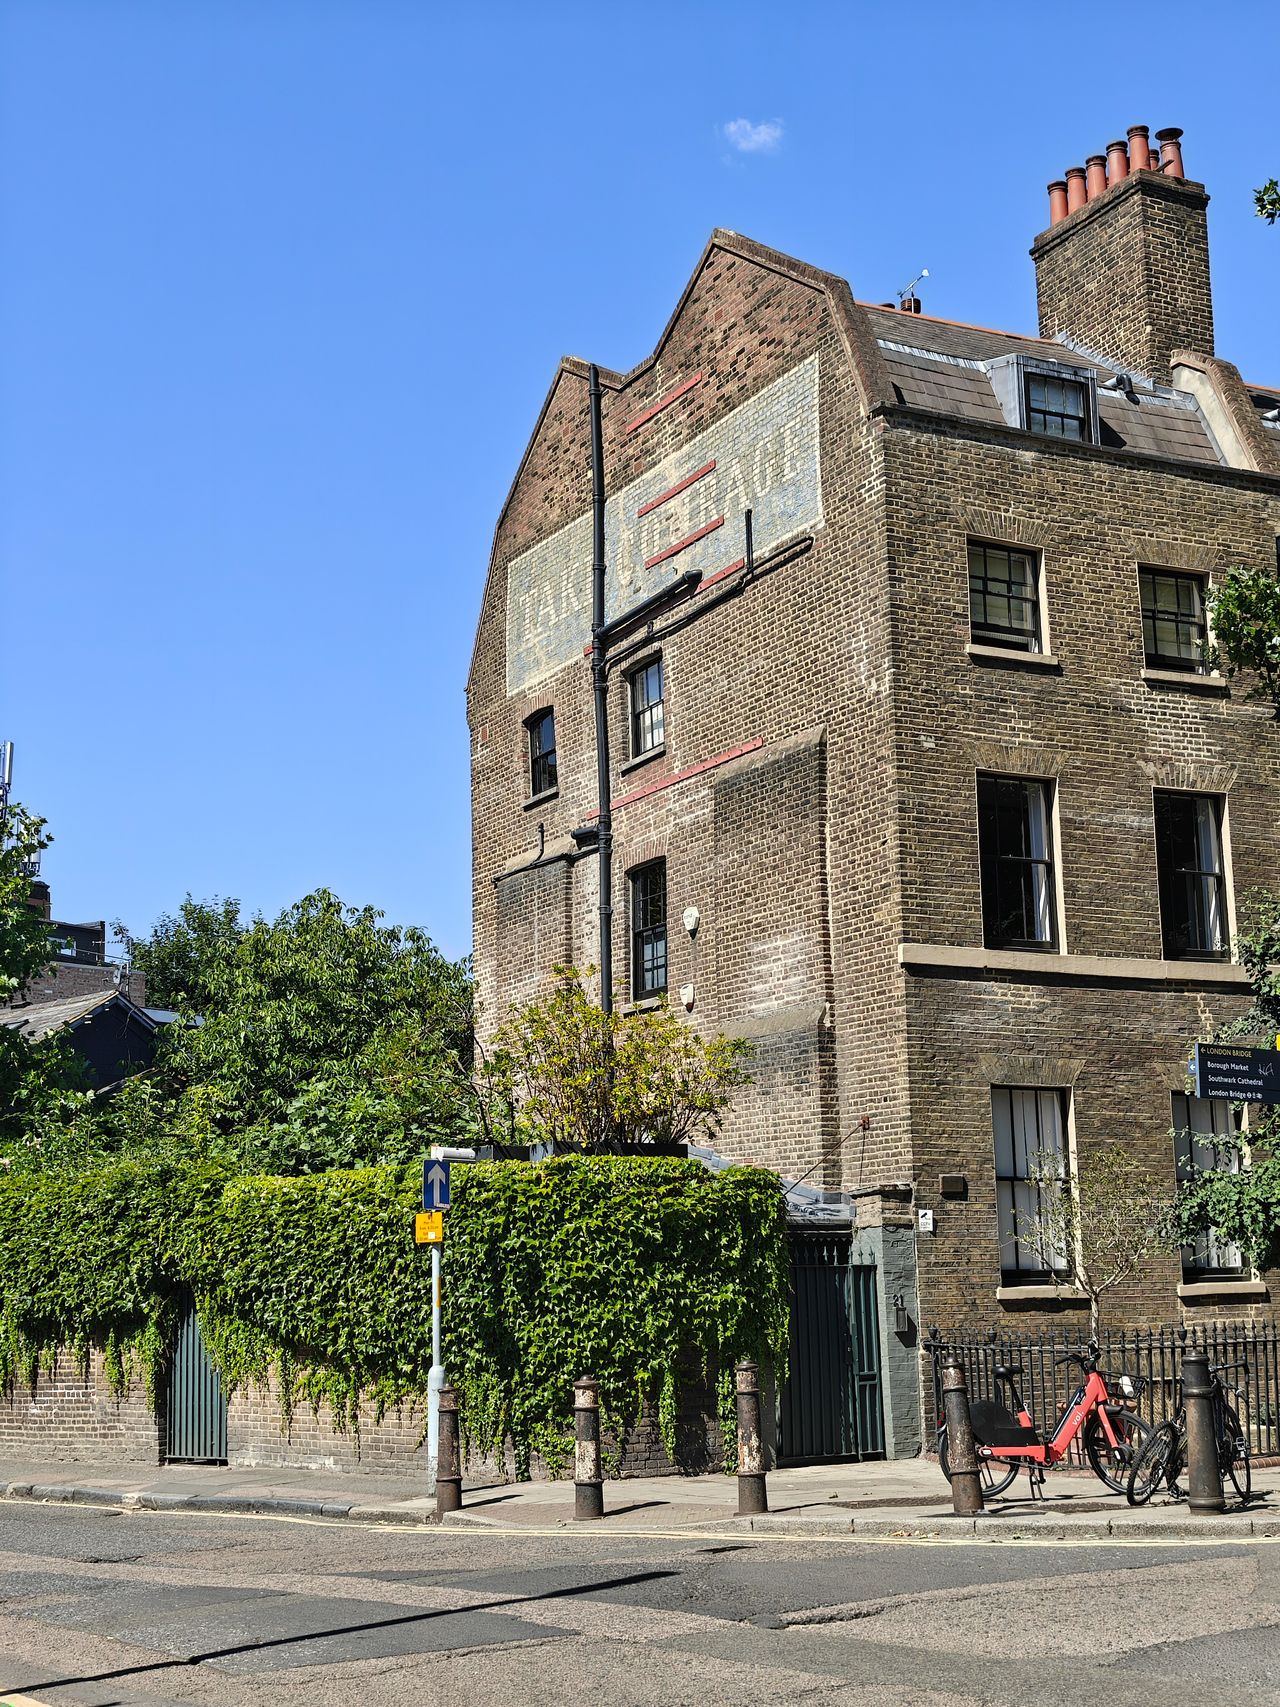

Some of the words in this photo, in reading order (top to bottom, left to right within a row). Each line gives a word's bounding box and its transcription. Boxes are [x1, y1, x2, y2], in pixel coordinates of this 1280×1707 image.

[1207, 1048, 1231, 1056] LONDON
[1232, 1050, 1252, 1058] BRIDGE
[1207, 1061, 1229, 1071] Borough
[1230, 1063, 1249, 1071] Market
[1208, 1075, 1236, 1083] Southwark
[1237, 1077, 1263, 1086] Cathedral
[1208, 1089, 1228, 1097] London
[1229, 1090, 1246, 1099] Bridge
[893, 1294, 904, 1307] 21
